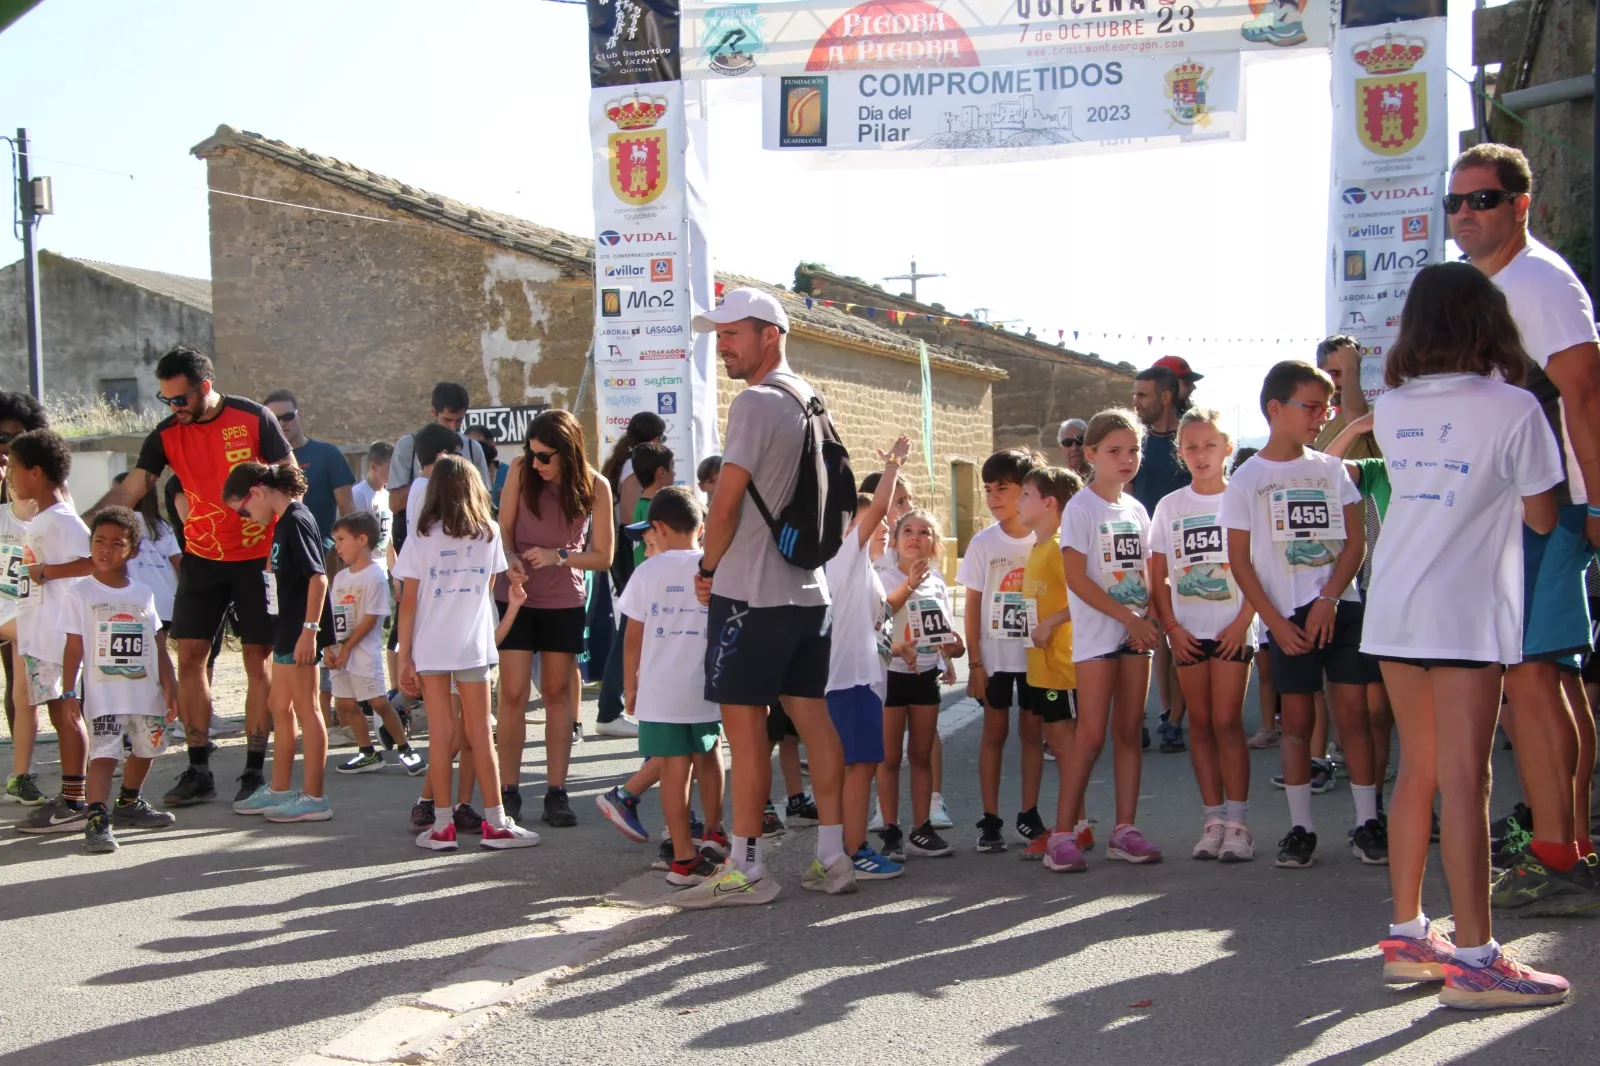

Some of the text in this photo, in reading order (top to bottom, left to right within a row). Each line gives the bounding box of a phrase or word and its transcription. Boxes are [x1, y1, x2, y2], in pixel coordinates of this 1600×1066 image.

[843, 12, 945, 37] PIEDRA
[1157, 5, 1195, 34] 23
[1019, 18, 1145, 43] 7 de OCTUBRE
[595, 48, 671, 61] Club Deportivo
[827, 38, 961, 70] A PIEDRA
[1027, 39, 1185, 57] www.trailmontearagon.com
[859, 61, 1124, 98] COMPROMETIDOS
[858, 105, 912, 121] Día del
[1086, 104, 1131, 123] 2023
[858, 123, 911, 143] Pilar
[1369, 186, 1434, 201] VIDAL
[622, 231, 677, 243] VIDAL
[1360, 224, 1396, 237] villar
[615, 264, 645, 276] villar
[1339, 294, 1376, 302] LABORAL
[604, 376, 683, 388] eboca seytam
[222, 424, 248, 441] SPEIS
[1290, 505, 1327, 525] 455
[1116, 538, 1140, 556] 457
[1185, 530, 1221, 550] 454
[924, 613, 950, 631] 414
[112, 637, 142, 653] 416
[746, 846, 755, 863] NIKE
